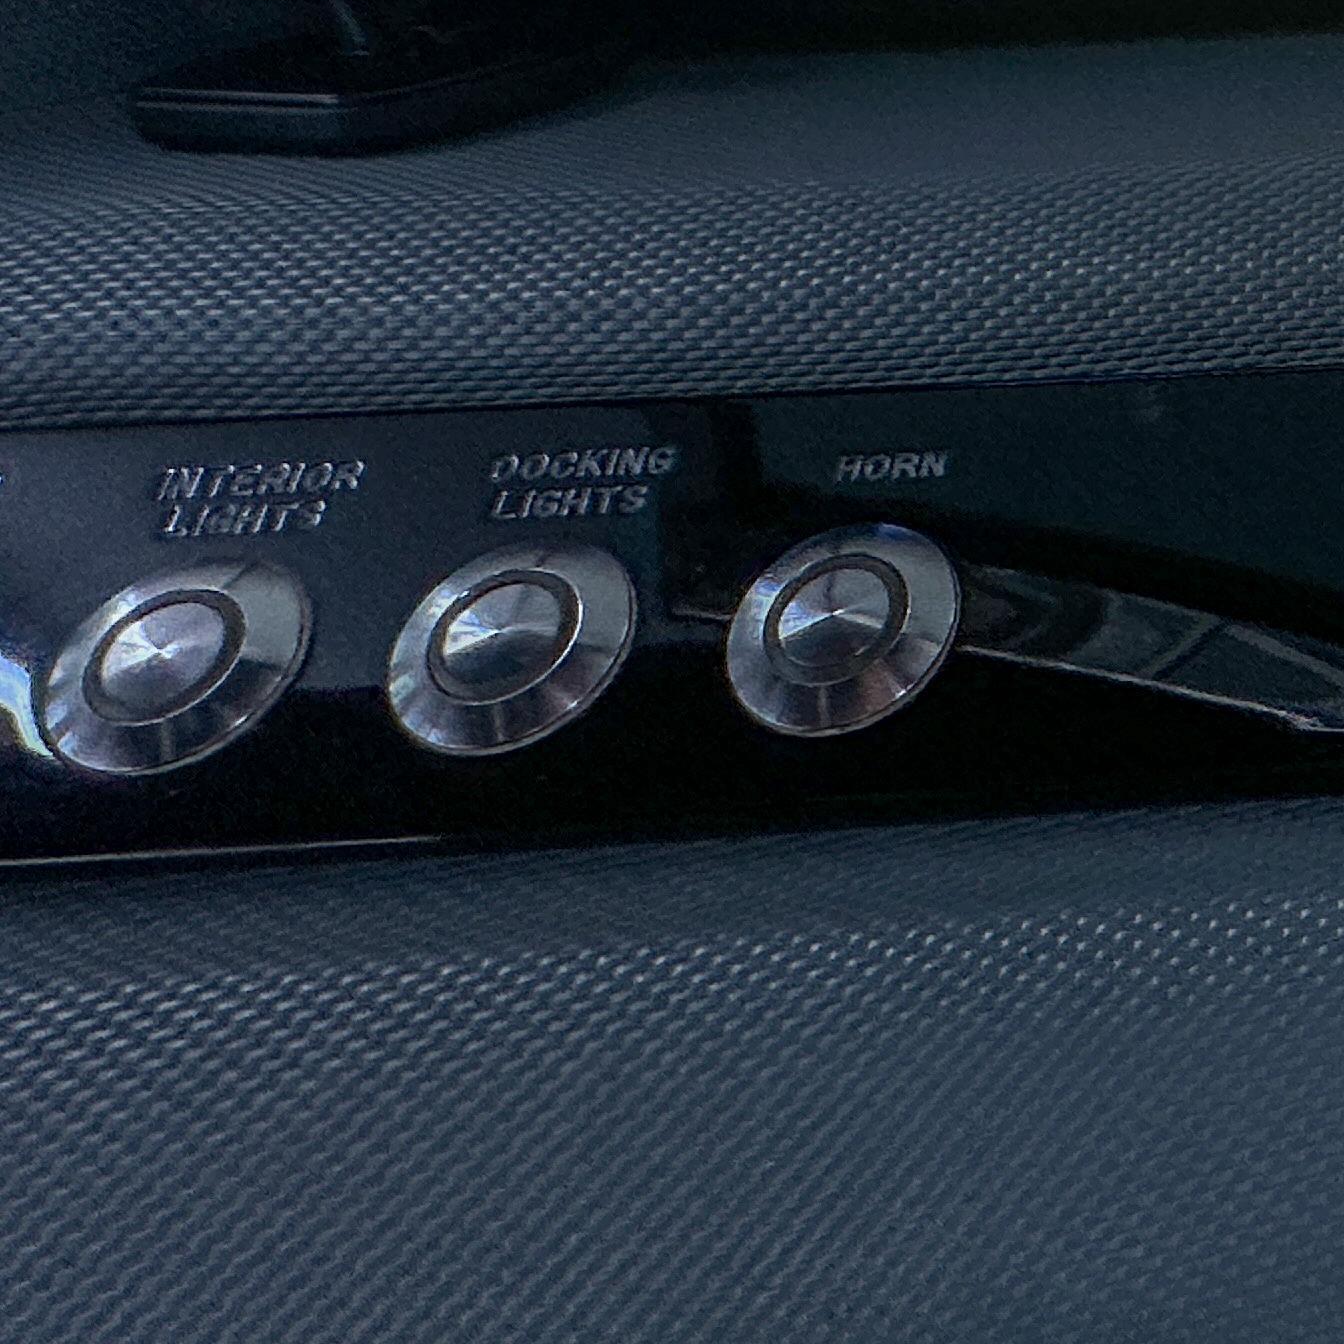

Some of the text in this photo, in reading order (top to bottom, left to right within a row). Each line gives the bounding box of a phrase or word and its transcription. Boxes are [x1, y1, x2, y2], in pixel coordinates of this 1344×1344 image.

[156, 460, 367, 502] INTERIOR
[489, 445, 677, 484] DOCKING
[834, 451, 949, 485] HORN
[161, 499, 328, 538] LIGHTS
[490, 484, 650, 521] LIGHTS
